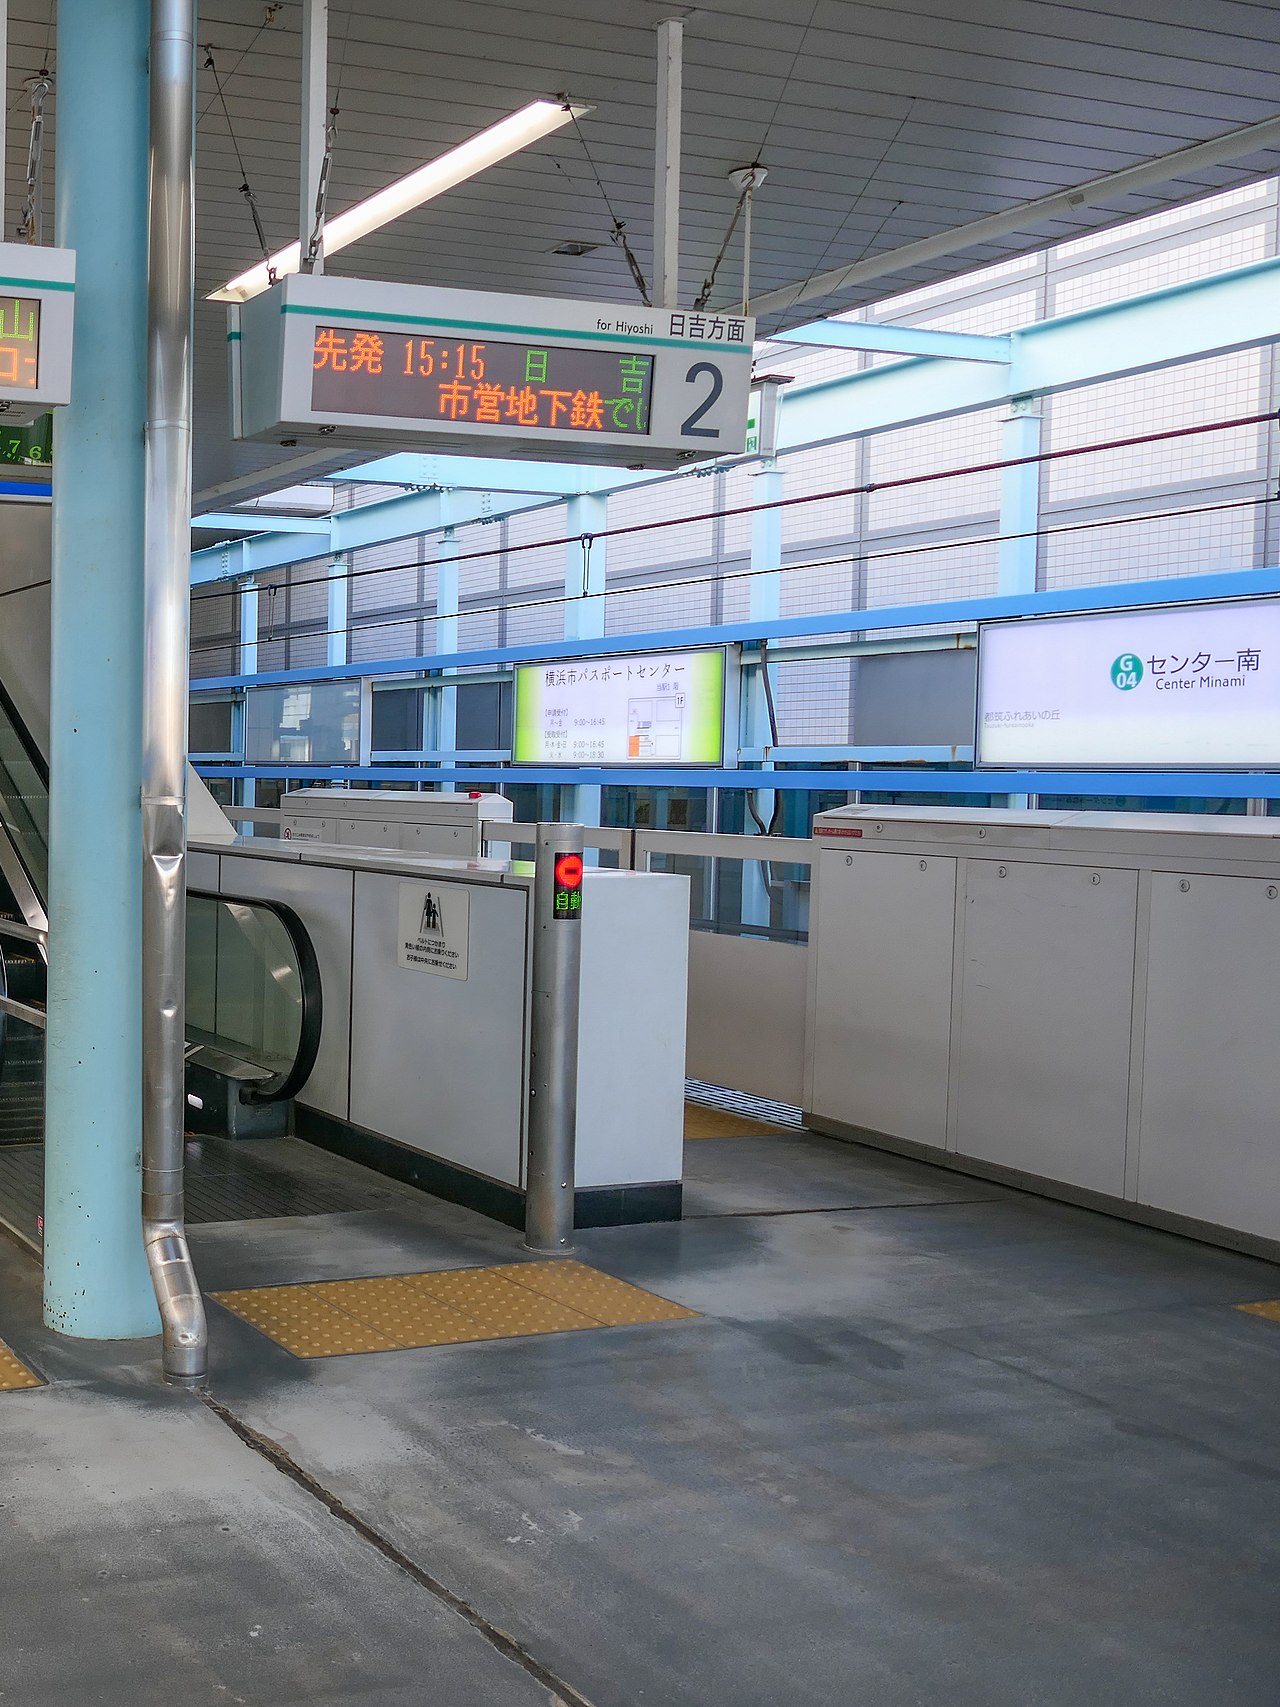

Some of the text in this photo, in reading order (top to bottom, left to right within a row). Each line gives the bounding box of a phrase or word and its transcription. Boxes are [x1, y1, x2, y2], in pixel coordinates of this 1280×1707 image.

[0, 299, 34, 342] 山
[596, 319, 654, 336] for Hiyoshi
[669, 313, 746, 343] 日吉方面
[313, 329, 650, 393] 先発 15:15 日 吉
[680, 361, 724, 438] 2
[9, 439, 21, 454] 7
[29, 445, 42, 460] 6
[1119, 654, 1133, 671] G
[1146, 647, 1262, 675] センター南
[545, 663, 686, 688] 横浜市パスポートセンター
[1116, 672, 1138, 689] 04
[1155, 674, 1246, 691] Center Minami
[676, 697, 684, 706] 1F
[984, 709, 1061, 722] 都筑ふれあいの丘
[555, 890, 582, 911] 自動
